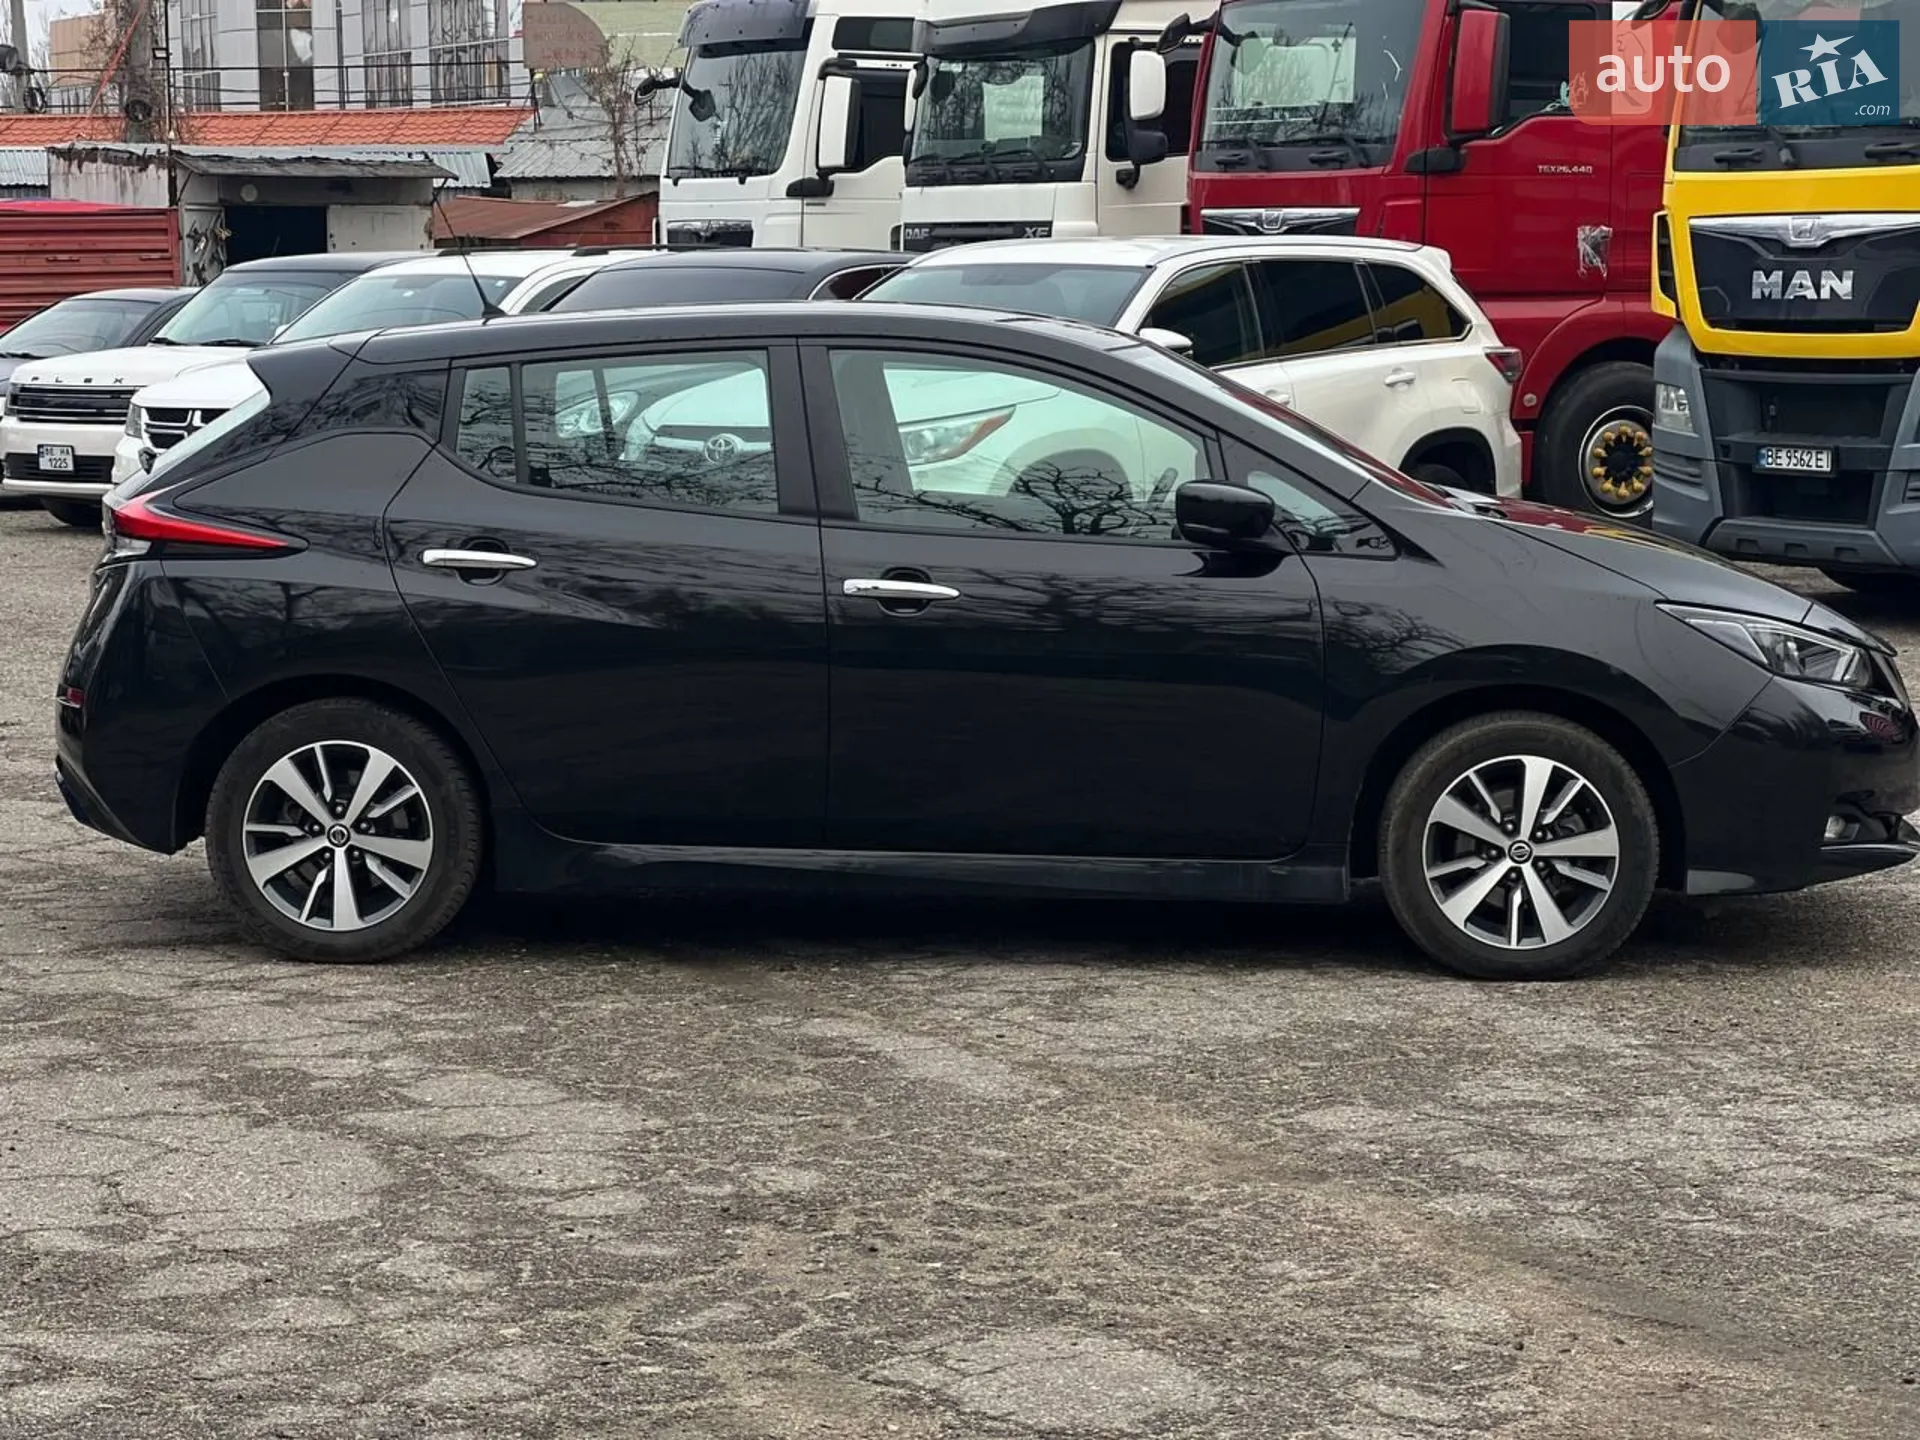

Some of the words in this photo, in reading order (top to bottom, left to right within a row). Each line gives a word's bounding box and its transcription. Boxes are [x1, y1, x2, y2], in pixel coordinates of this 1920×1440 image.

[905, 227, 930, 241] DAF
[1751, 270, 1854, 300] MAN
[1766, 448, 1783, 466] BE
[1785, 449, 1813, 468] 9562
